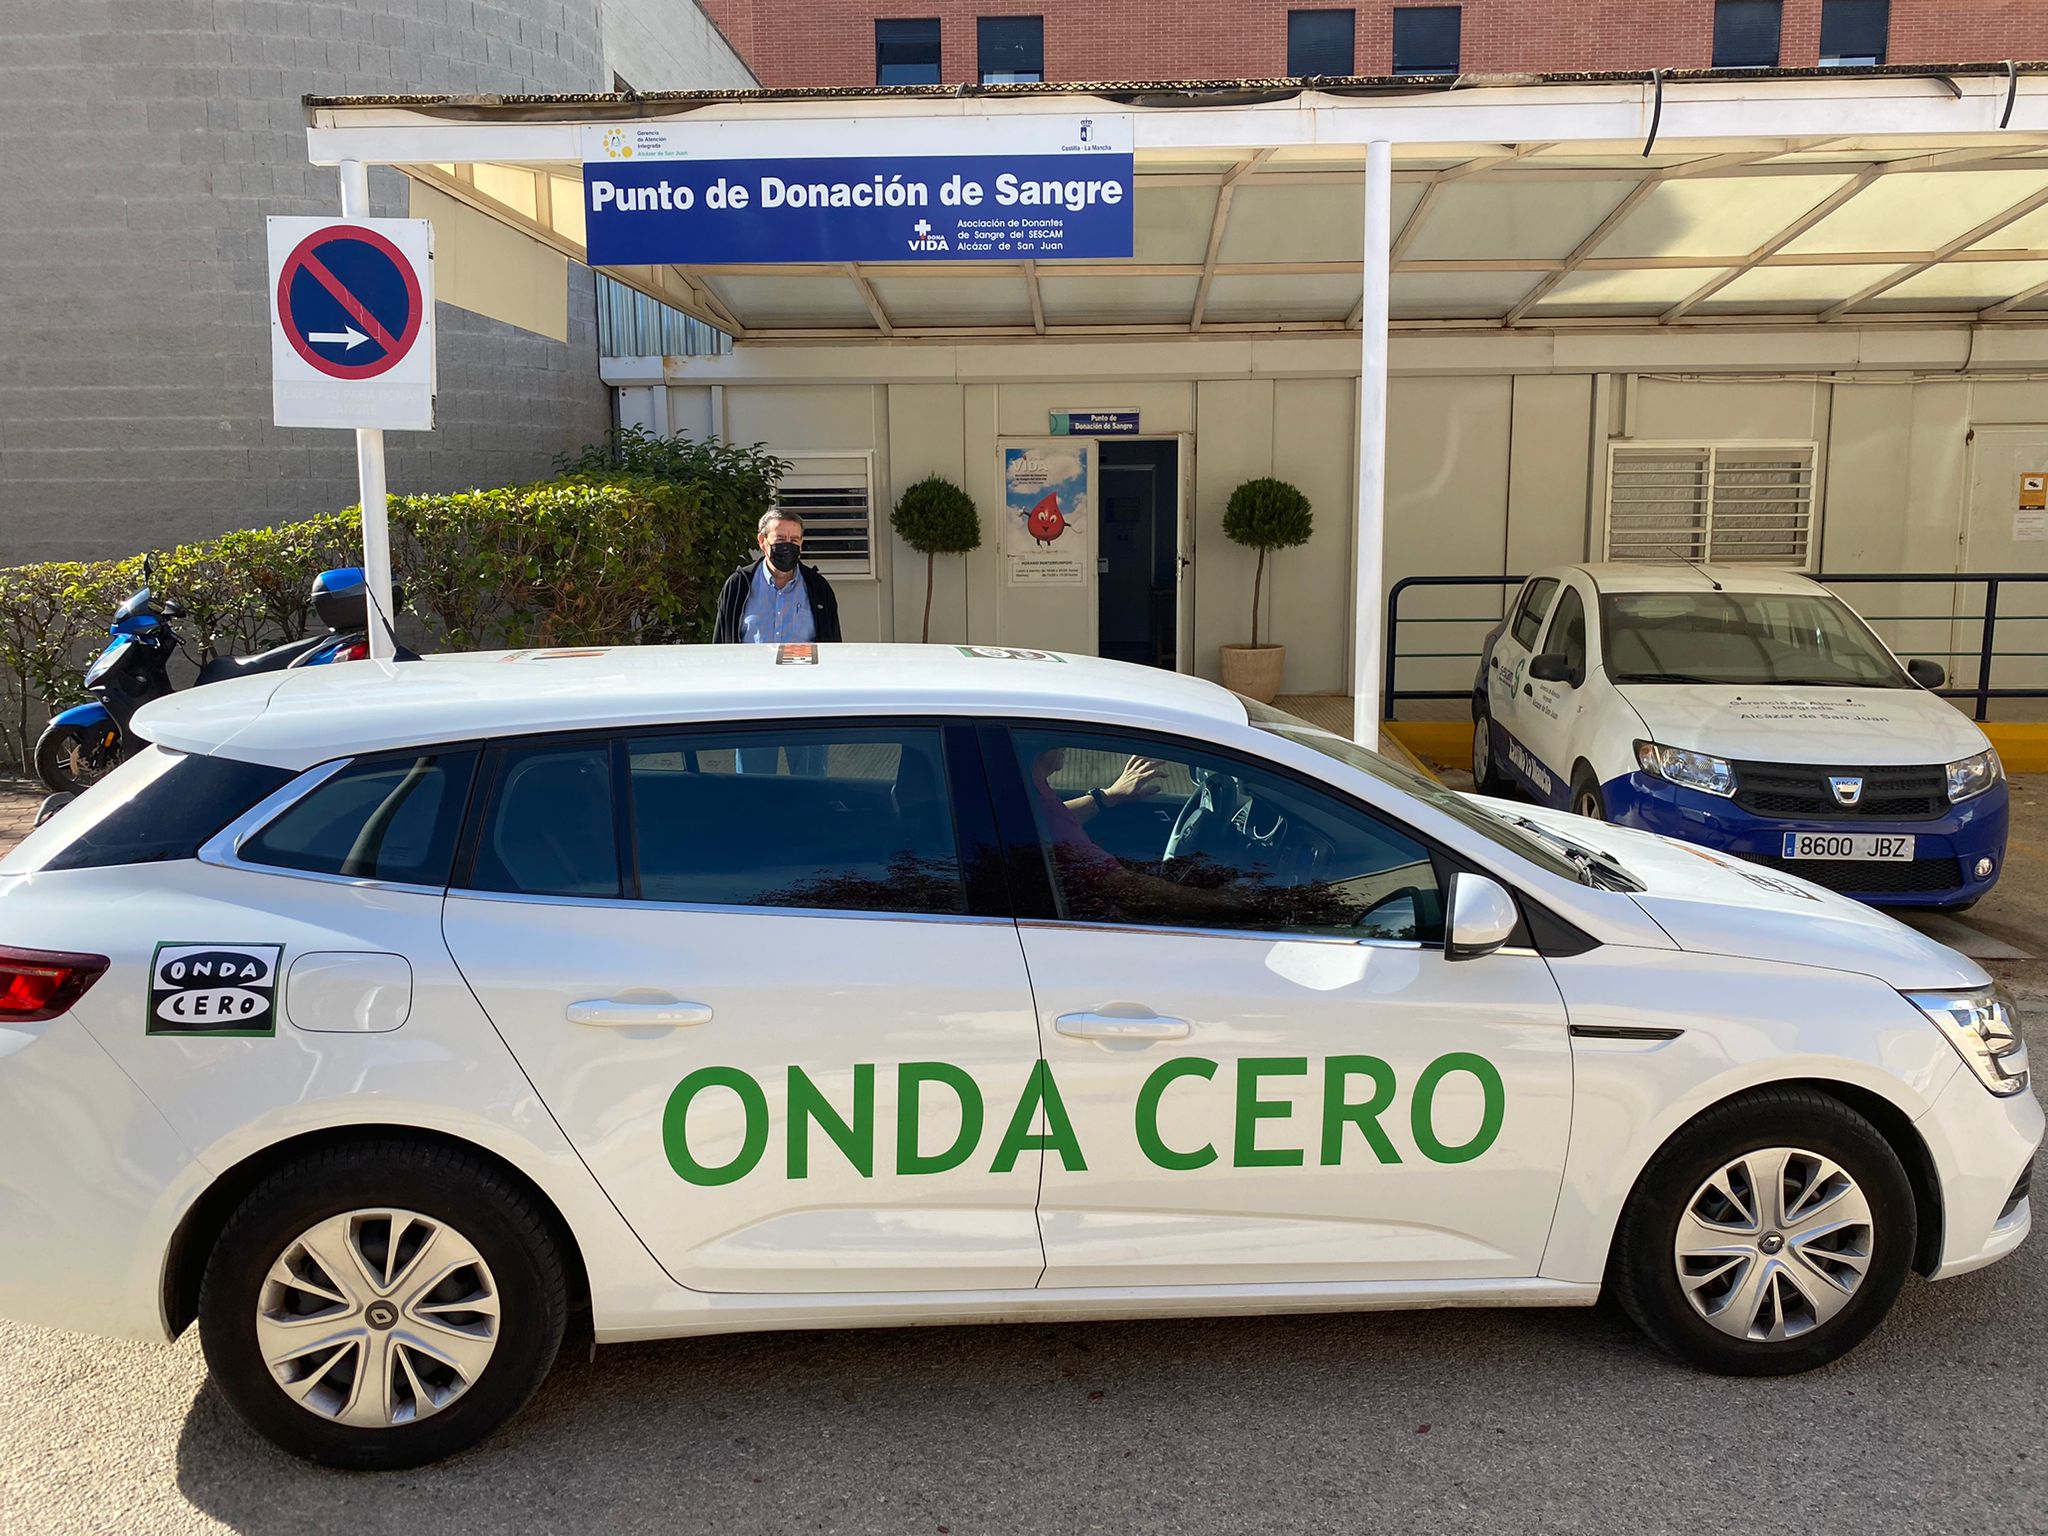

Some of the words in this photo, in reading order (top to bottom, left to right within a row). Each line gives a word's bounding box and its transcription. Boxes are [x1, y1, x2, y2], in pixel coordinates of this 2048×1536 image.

[592, 181, 694, 211] Punto
[706, 178, 749, 209] de
[761, 175, 928, 208] Donación
[939, 174, 983, 206] de
[995, 173, 1123, 212] Sangre
[957, 218, 1005, 228] Asociación
[1007, 218, 1019, 227] de
[1021, 218, 1063, 227] Donantes
[957, 231, 970, 239] de
[974, 230, 1005, 241] Sangre
[1009, 230, 1024, 239] del
[1028, 230, 1063, 238] SESCAM
[908, 240, 949, 251] VIDA
[957, 242, 992, 250] Alcázar
[998, 241, 1011, 250] de
[1017, 241, 1034, 250] San
[1040, 241, 1063, 250] Juan
[1800, 836, 1853, 856] 8600
[1867, 838, 1906, 857] JBZ
[170, 961, 257, 980] ONDA
[172, 995, 255, 1016] CERO
[662, 1058, 1088, 1187] ONDA
[1135, 1052, 1506, 1172] CERO
